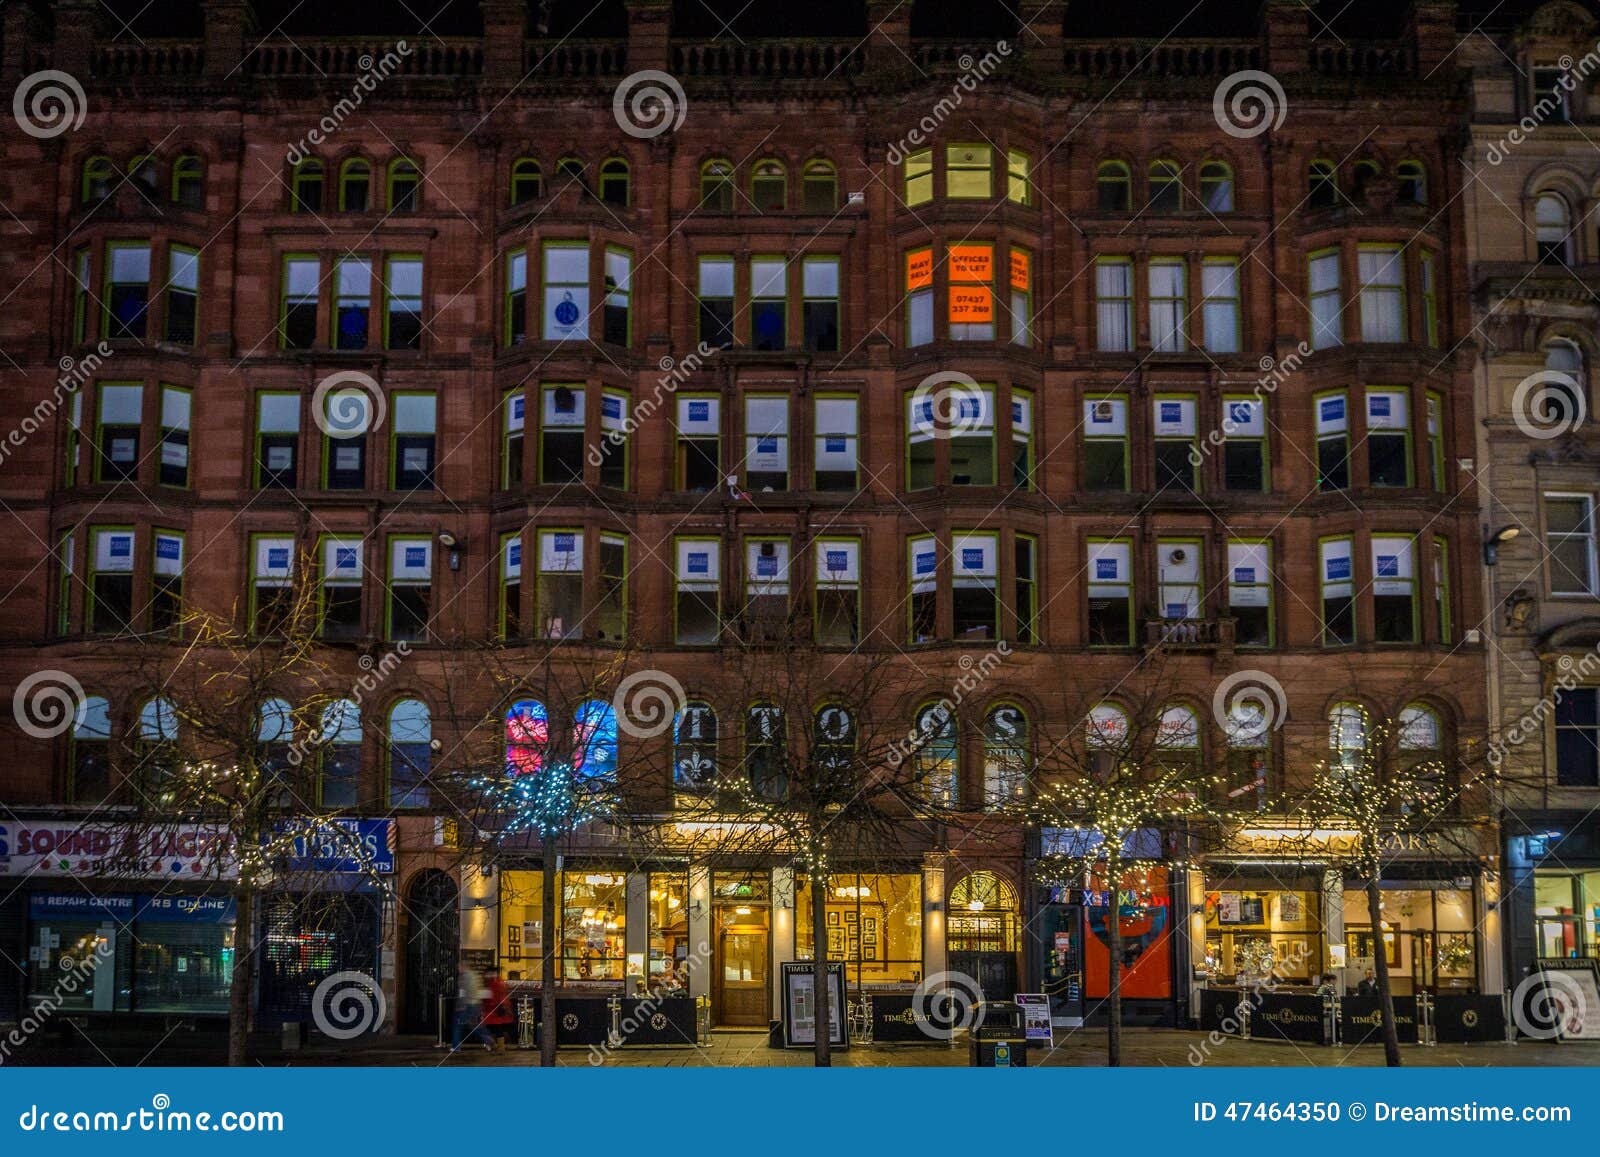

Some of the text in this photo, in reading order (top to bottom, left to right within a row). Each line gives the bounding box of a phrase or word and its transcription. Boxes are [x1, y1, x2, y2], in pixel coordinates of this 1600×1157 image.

[18, 829, 111, 855] SOUND
[48, 896, 86, 906] REPAIR
[89, 897, 133, 907] CENTRE
[152, 899, 171, 908] RS
